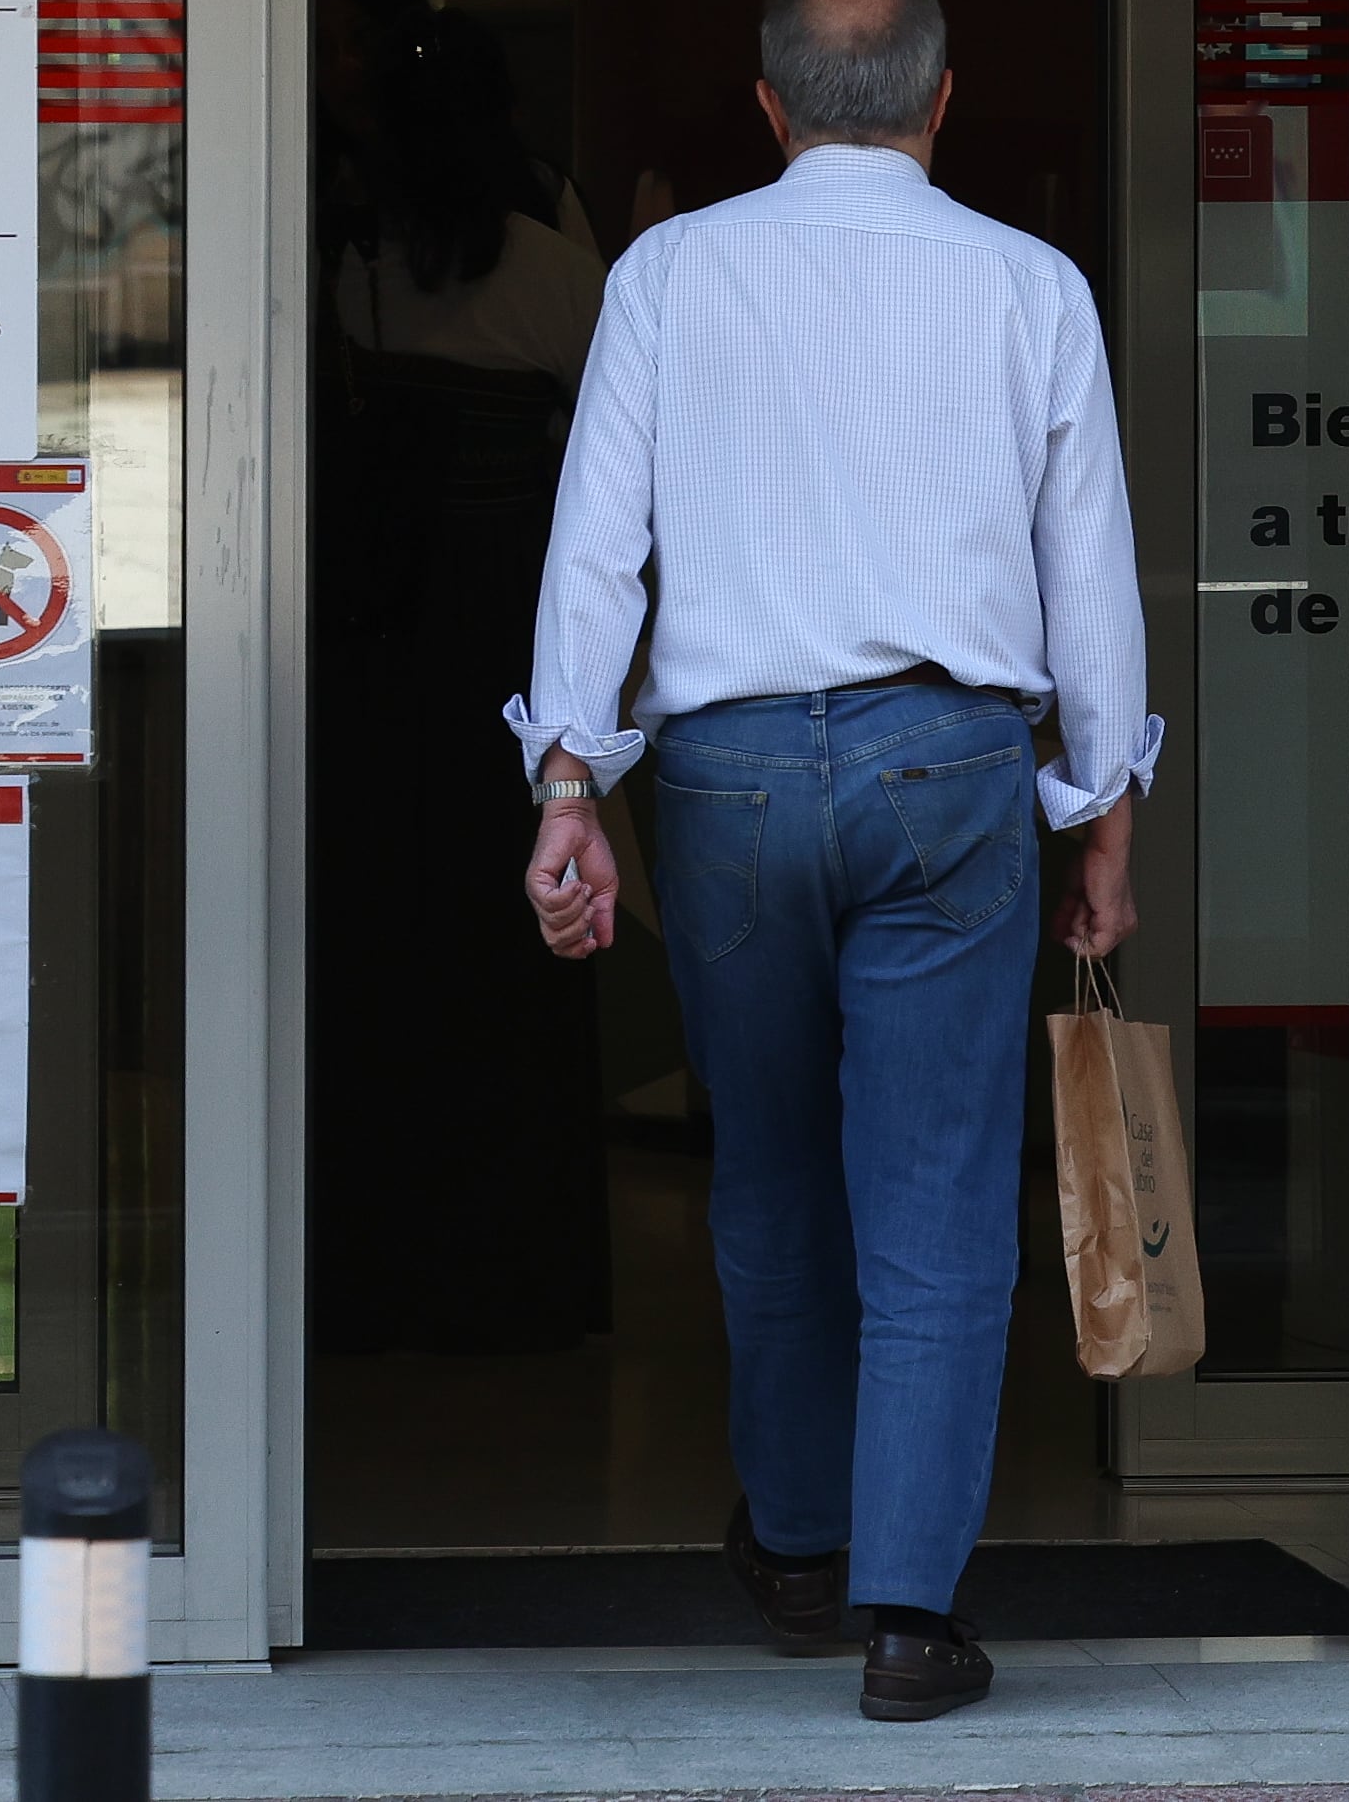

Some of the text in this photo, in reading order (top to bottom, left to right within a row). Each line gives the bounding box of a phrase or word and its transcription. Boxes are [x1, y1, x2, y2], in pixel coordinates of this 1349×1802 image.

[1250, 506, 1290, 546] a
[1250, 585, 1339, 634] de
[1131, 1114, 1153, 1142] Casa
